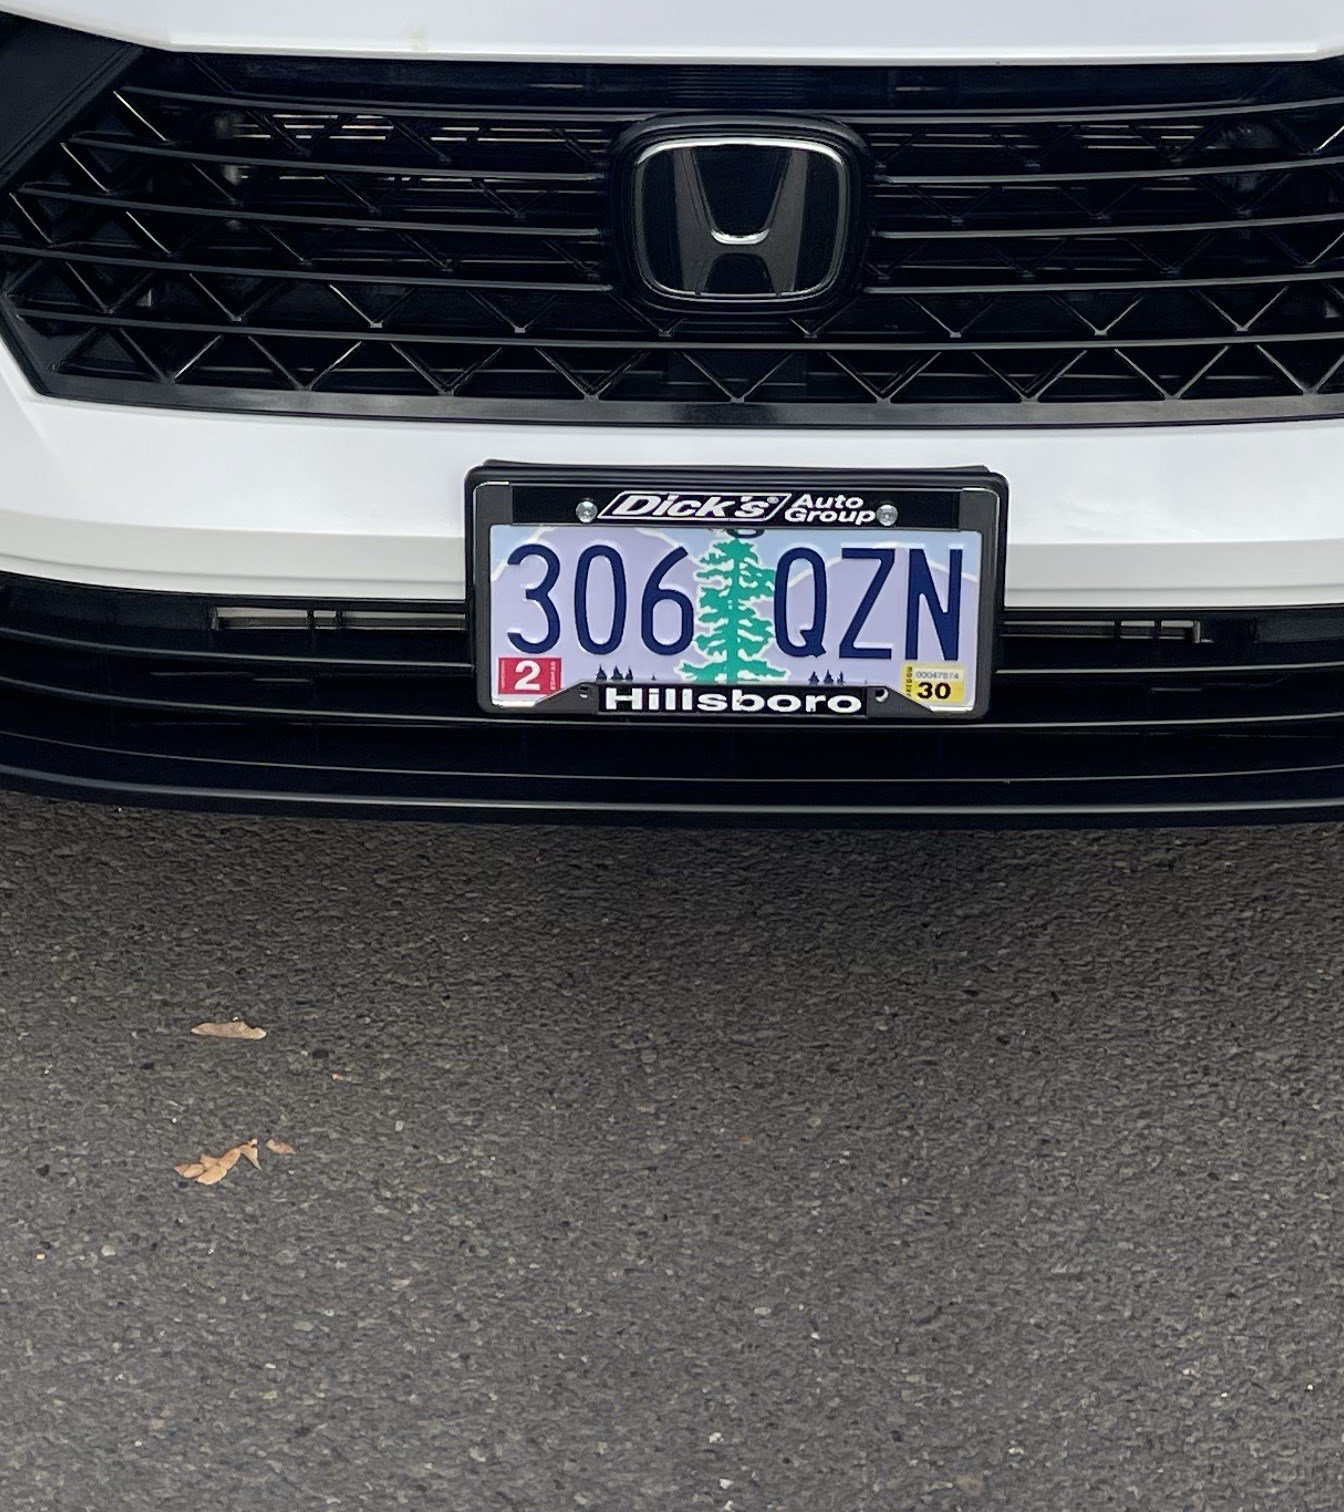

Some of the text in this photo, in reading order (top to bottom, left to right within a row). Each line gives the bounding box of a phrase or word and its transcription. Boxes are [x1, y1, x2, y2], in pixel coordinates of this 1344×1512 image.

[612, 494, 769, 518] Dick's
[792, 494, 864, 509] Auto
[784, 507, 876, 526] Group
[506, 544, 963, 662] 306 QZN
[515, 660, 541, 691] 2
[606, 687, 861, 714] Hillsboro
[917, 681, 951, 700] 30
